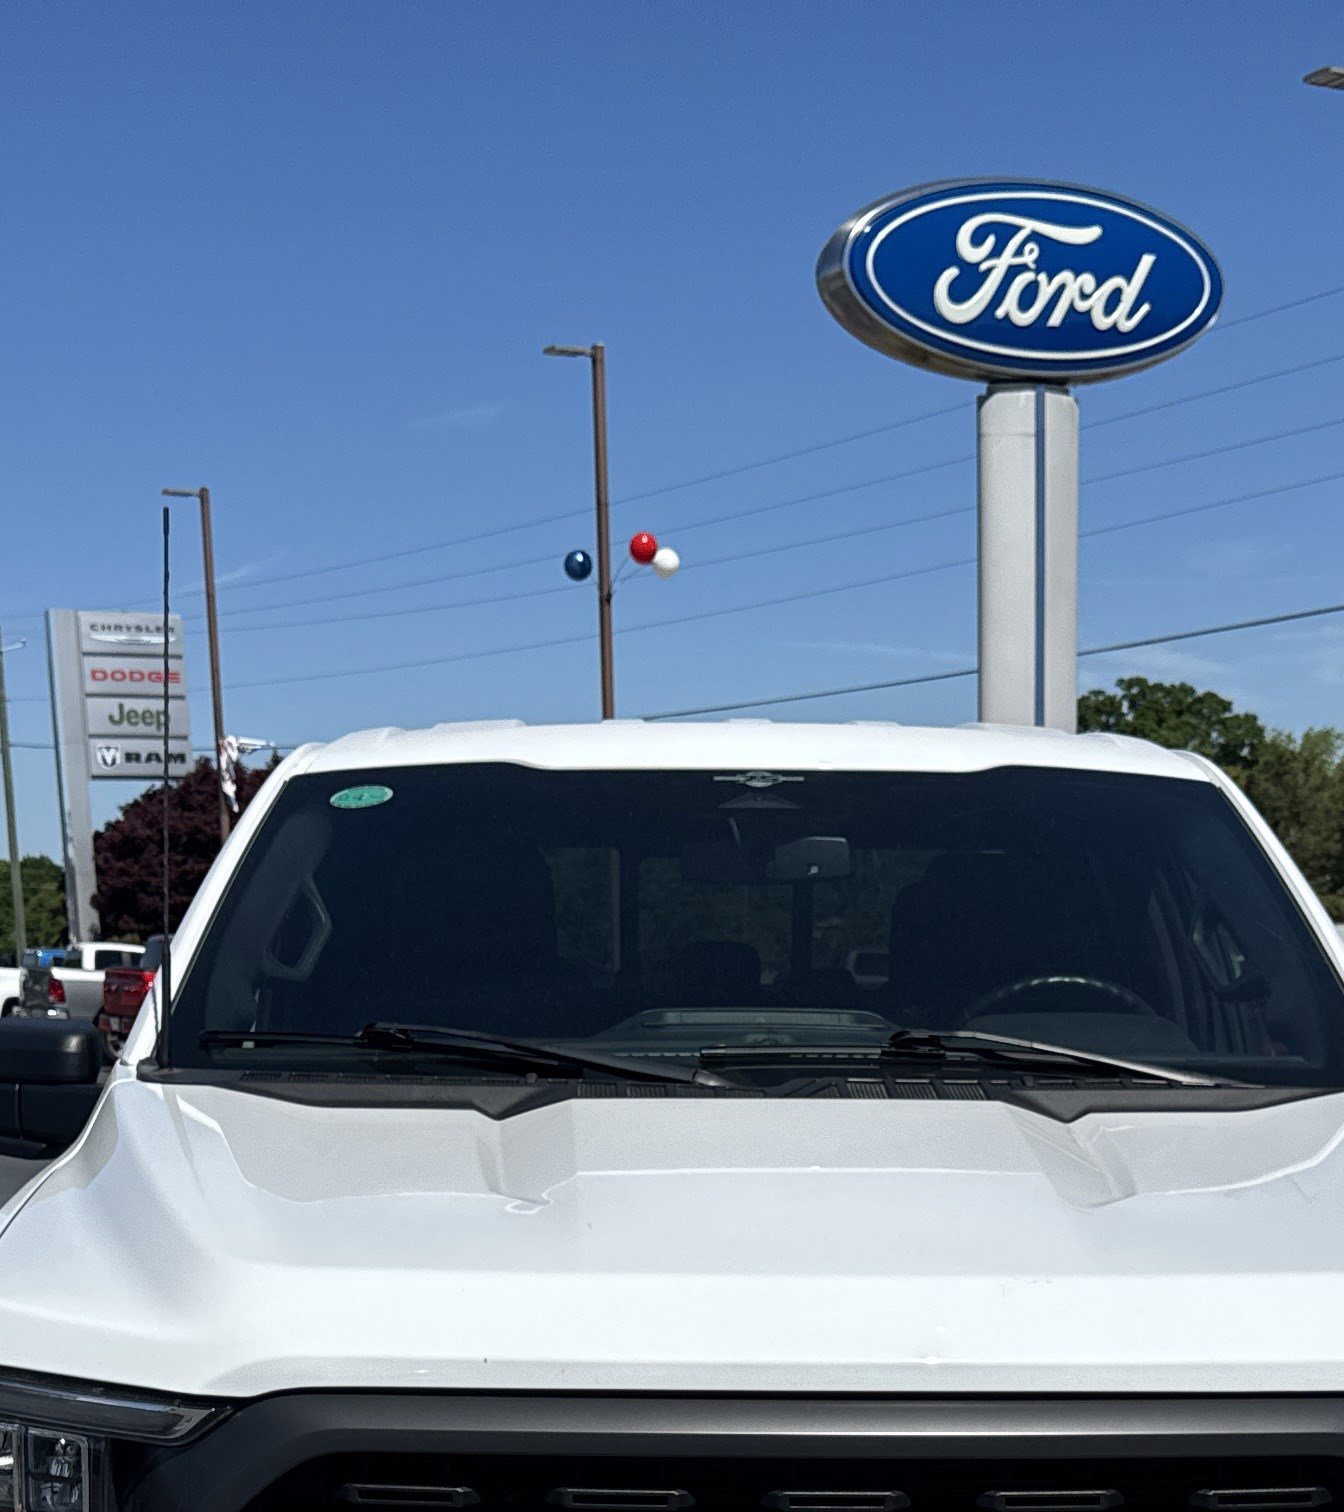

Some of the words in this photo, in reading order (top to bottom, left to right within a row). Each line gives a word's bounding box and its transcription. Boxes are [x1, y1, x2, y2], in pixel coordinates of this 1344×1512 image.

[933, 212, 1156, 334] Ford
[90, 667, 181, 684] DODGE
[108, 702, 171, 731] Jeep
[124, 751, 187, 764] RAM
